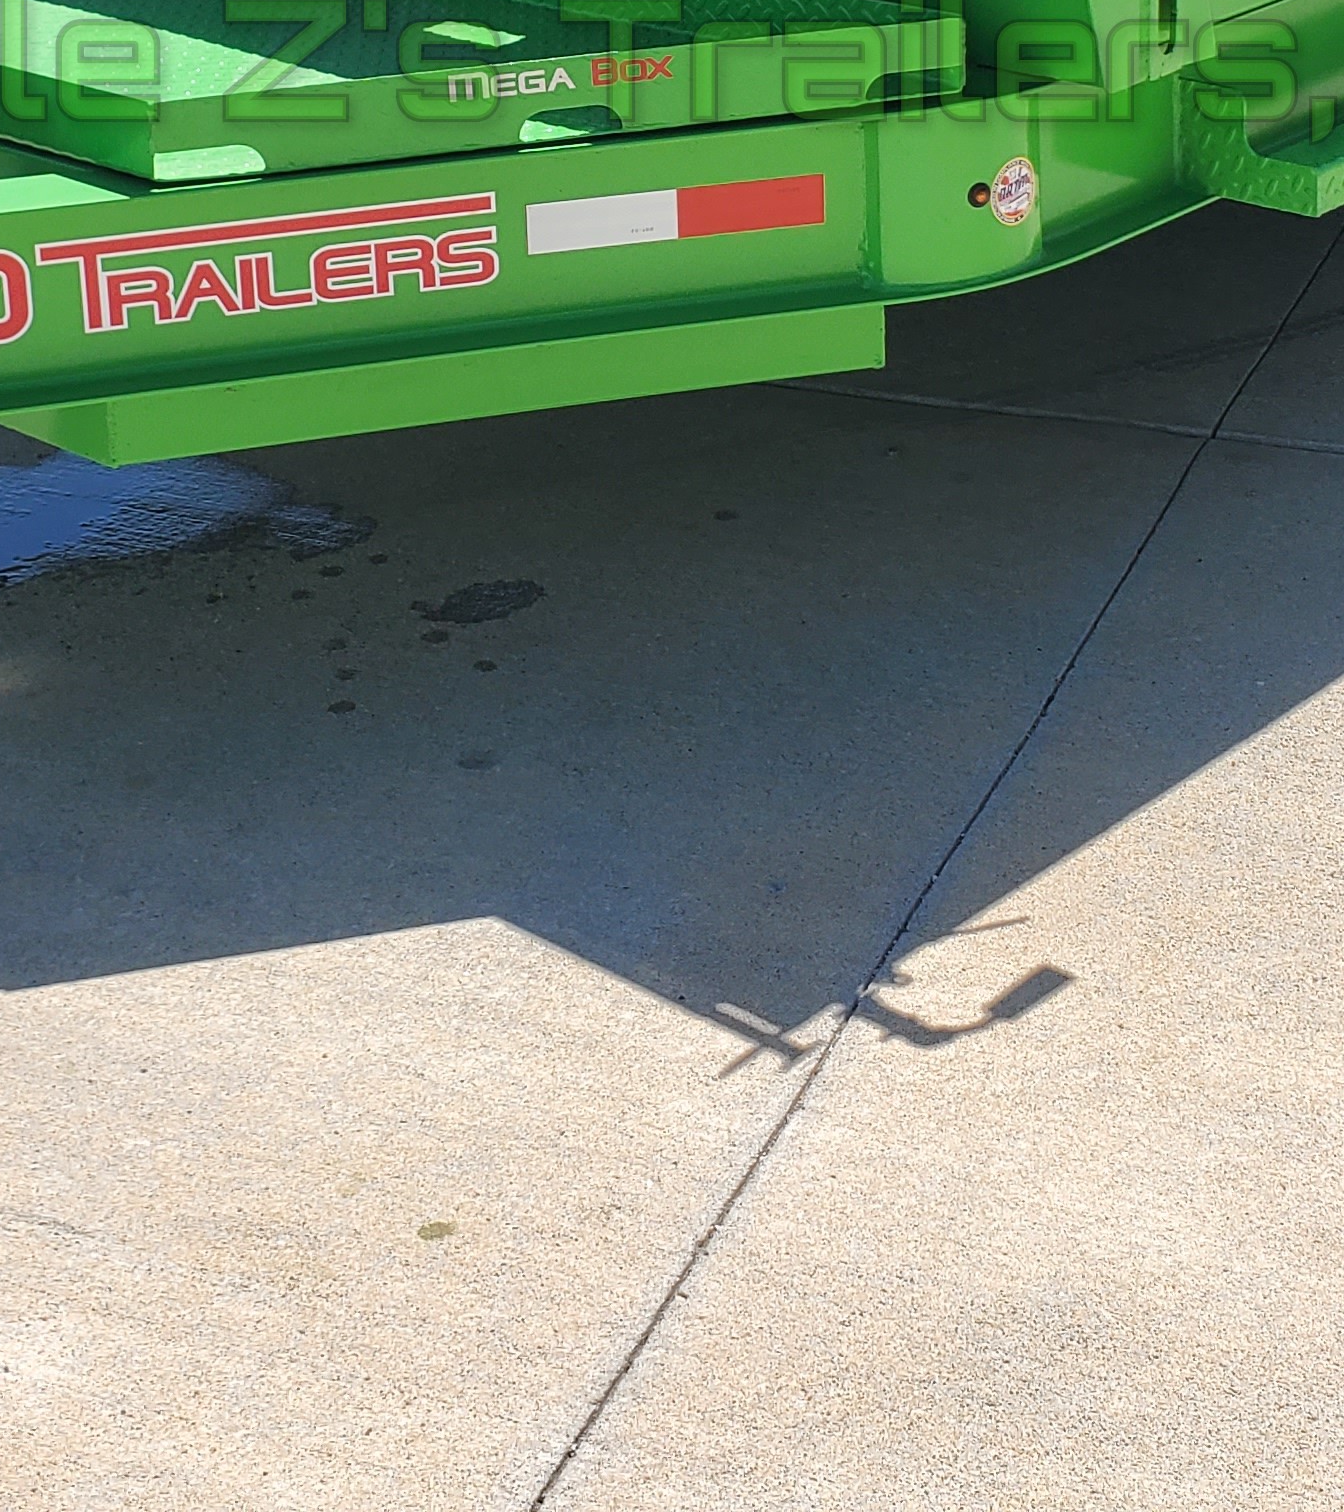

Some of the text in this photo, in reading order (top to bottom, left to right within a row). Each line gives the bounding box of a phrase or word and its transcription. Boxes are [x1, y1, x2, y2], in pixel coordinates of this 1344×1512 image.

[447, 54, 676, 103] MEGA BOX
[35, 191, 500, 334] TRAILERS
